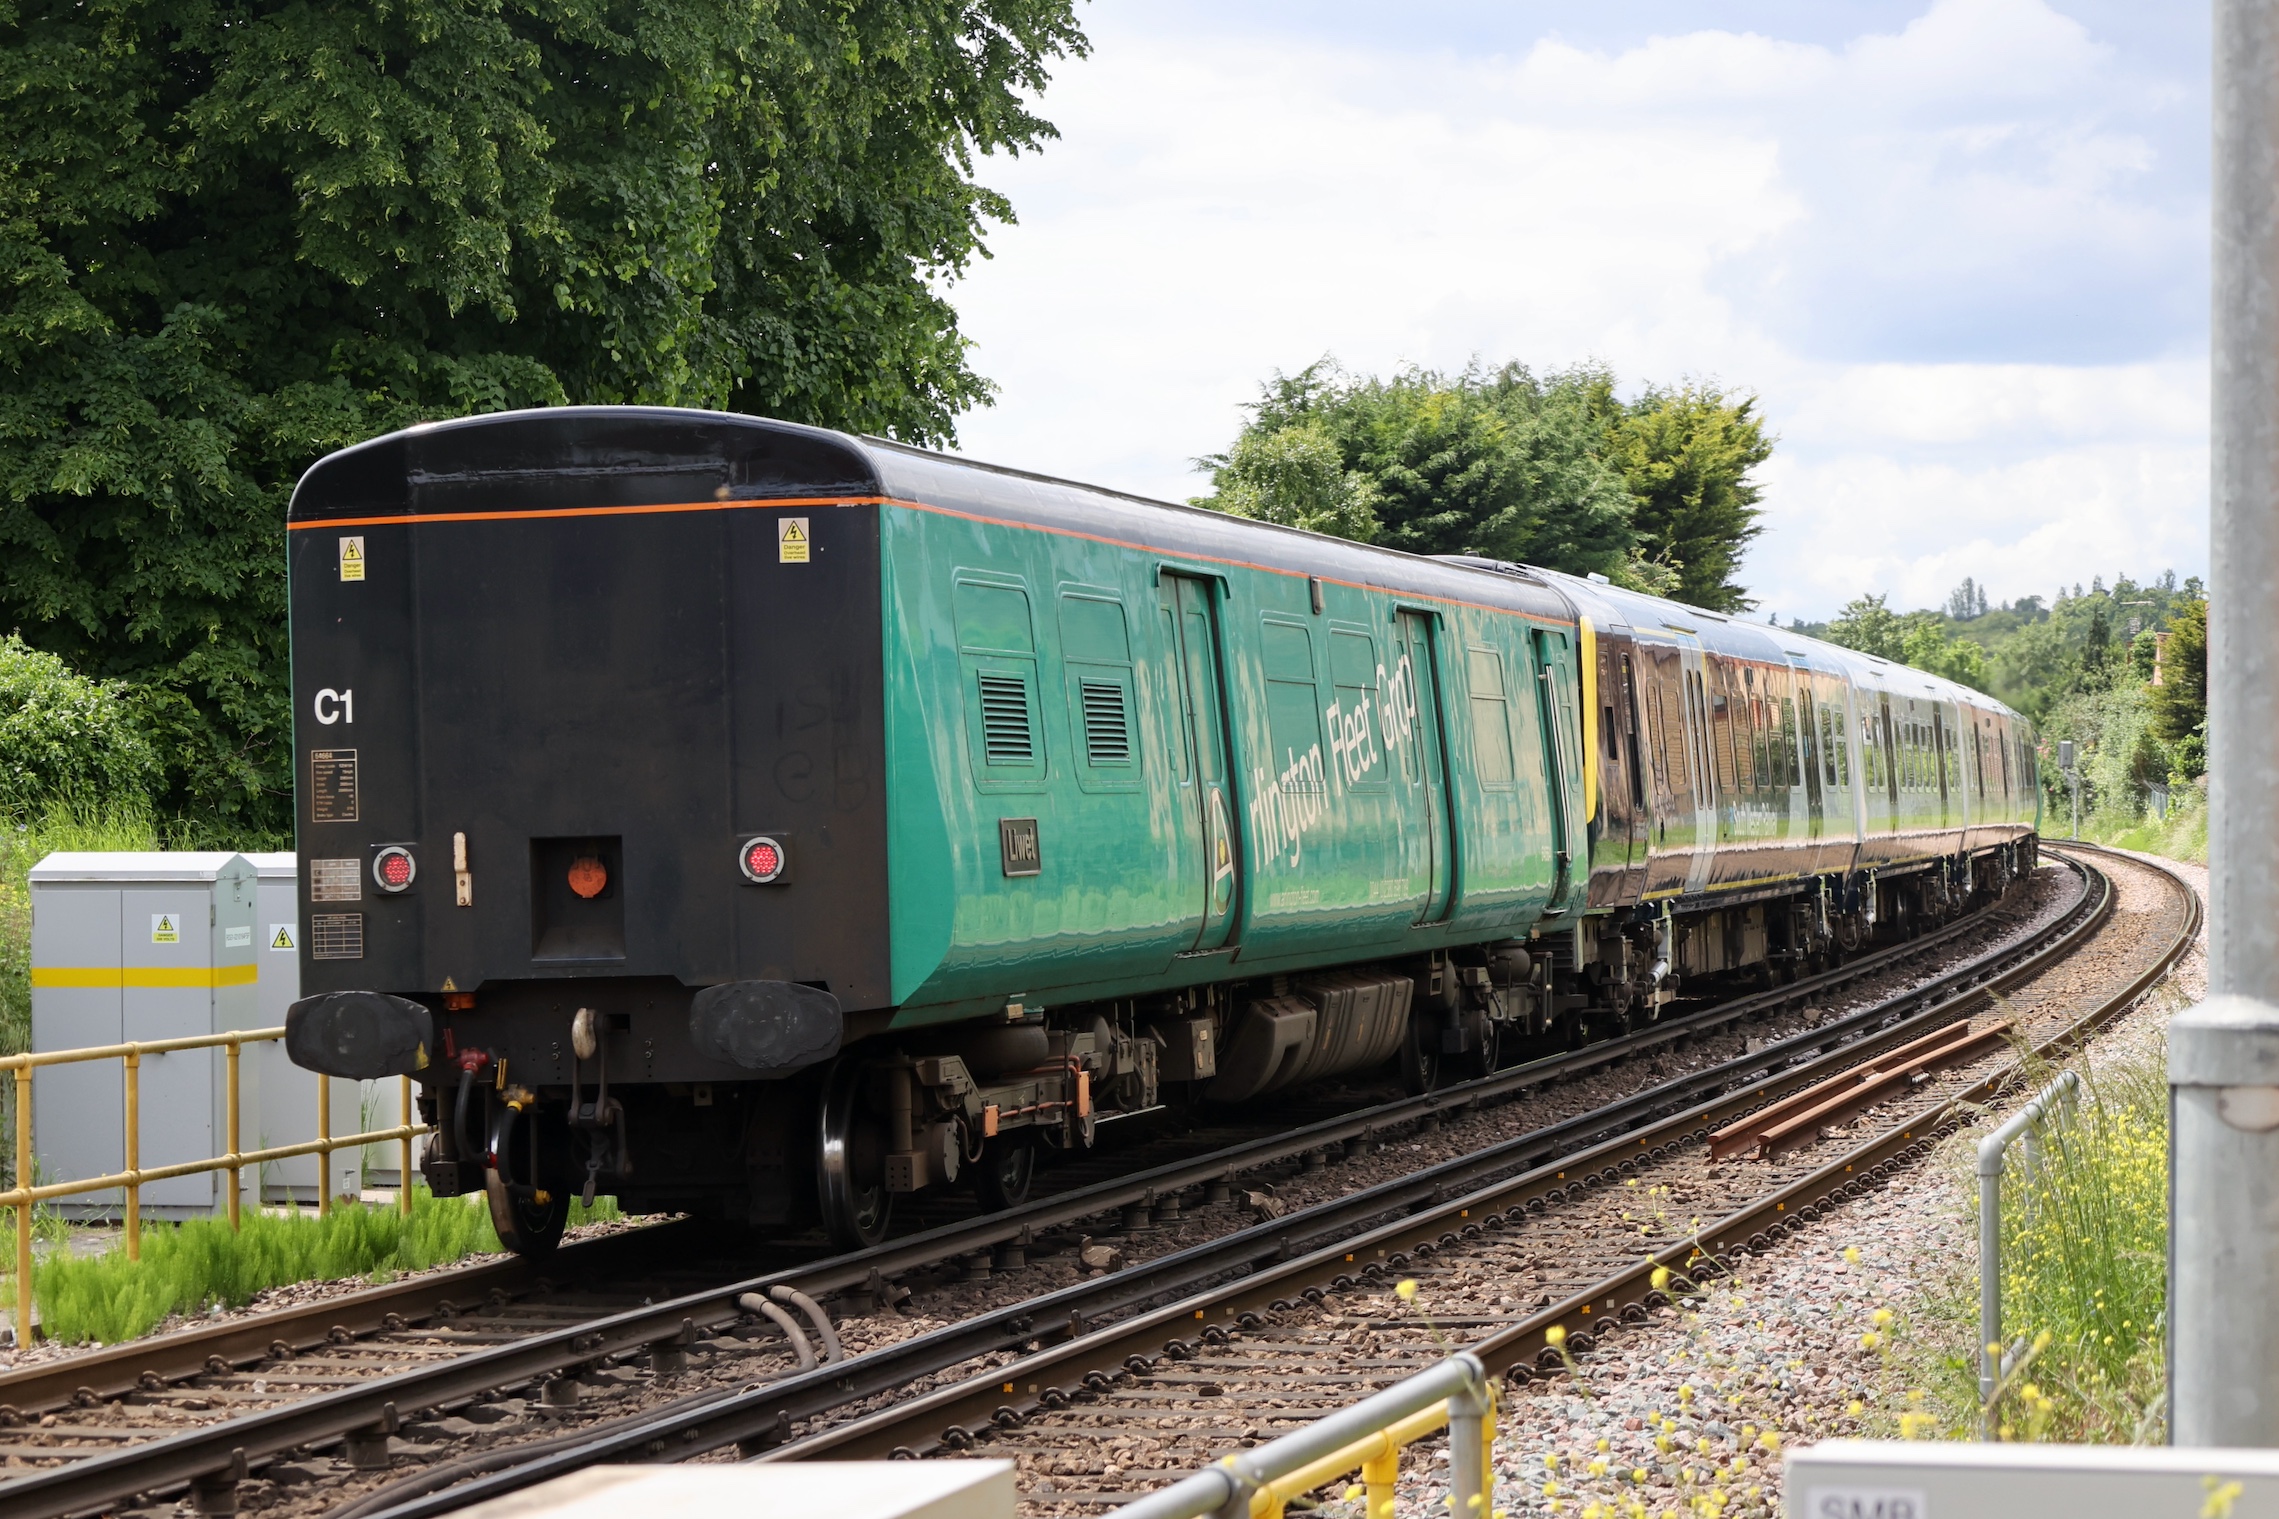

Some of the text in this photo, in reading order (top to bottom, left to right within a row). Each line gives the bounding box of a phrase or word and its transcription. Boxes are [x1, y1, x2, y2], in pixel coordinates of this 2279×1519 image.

[314, 688, 353, 725] C1
[1326, 683, 1378, 798] Fleet
[1006, 827, 1036, 861] Liwet
